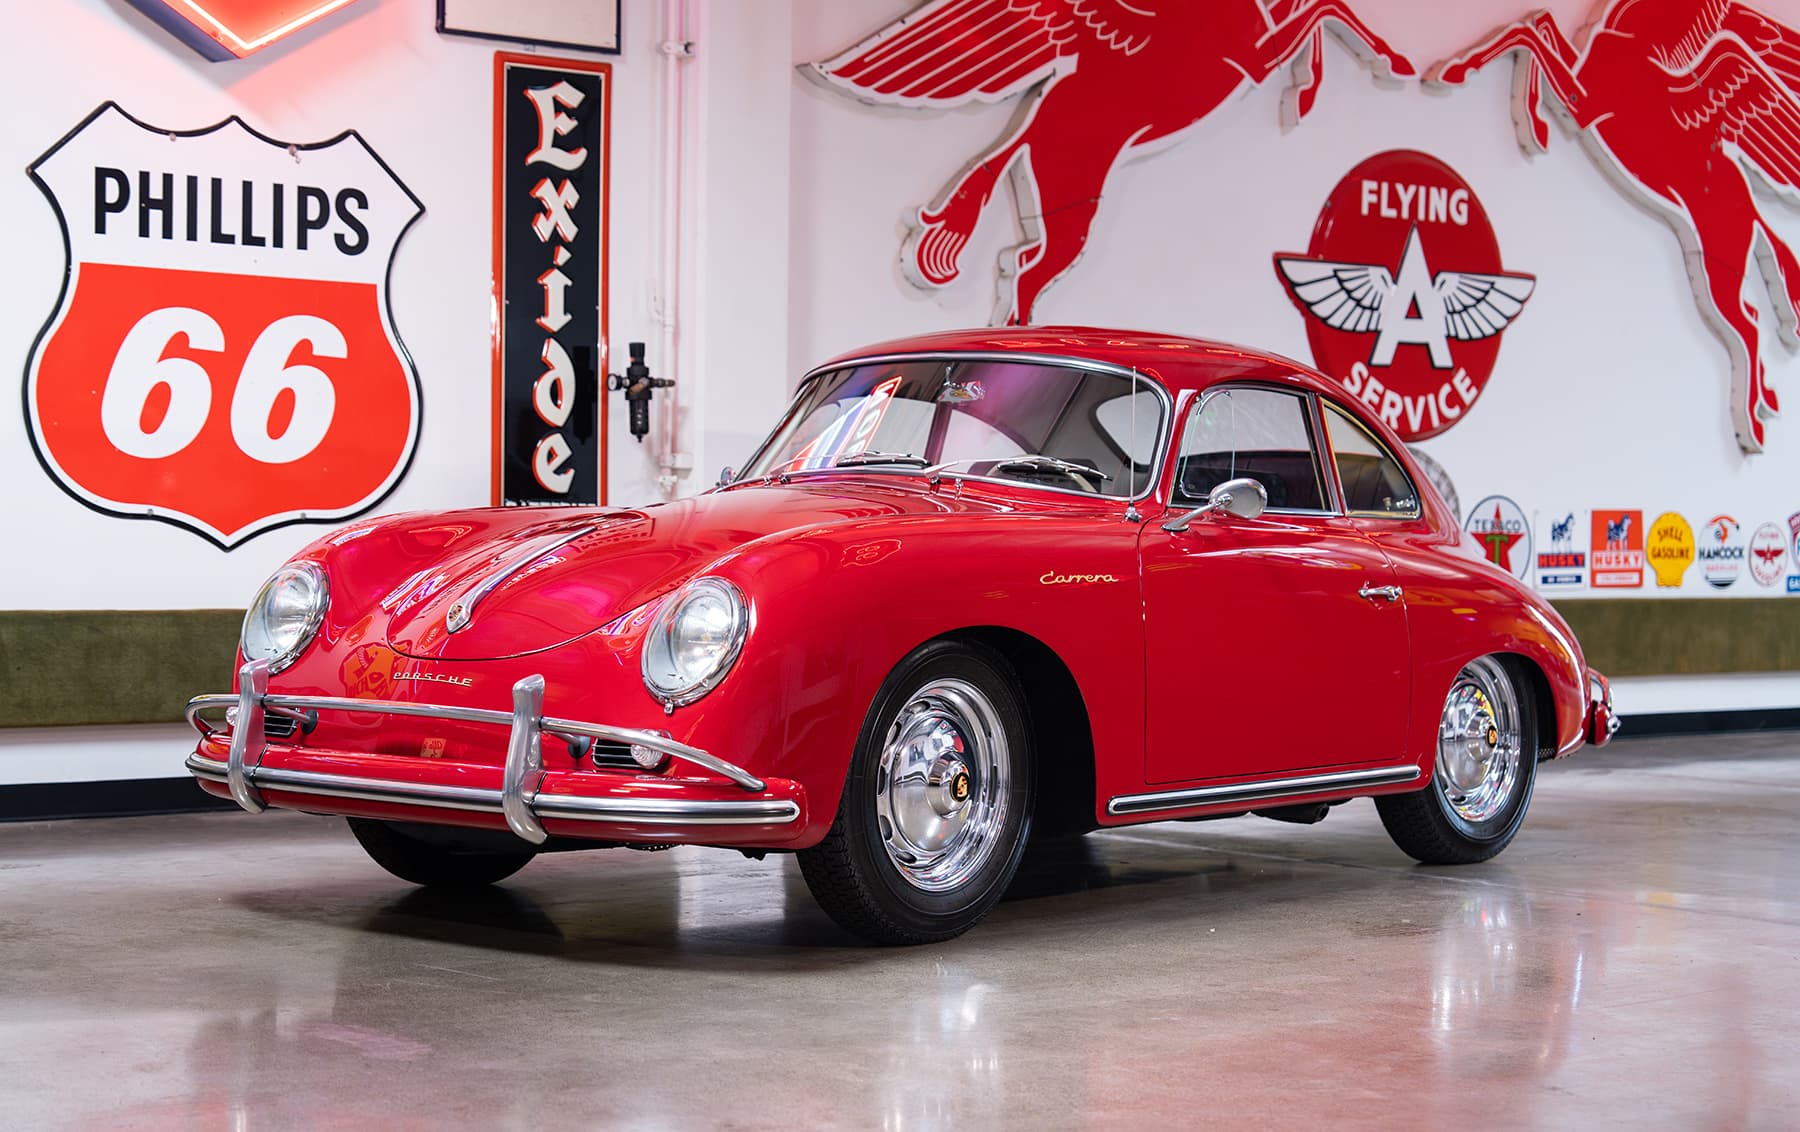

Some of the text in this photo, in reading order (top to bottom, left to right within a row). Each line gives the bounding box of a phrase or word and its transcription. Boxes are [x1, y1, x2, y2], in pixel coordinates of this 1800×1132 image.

[1361, 179, 1469, 226] FLYING
[94, 166, 369, 256] PHILLIPS
[524, 80, 588, 494] Exide
[1367, 221, 1454, 369] A
[101, 306, 349, 464] 66
[1343, 361, 1478, 432] SERVICE
[1474, 519, 1522, 533] TEXACO
[1657, 526, 1684, 542] SHELL
[1594, 553, 1640, 567] HUSKY
[1651, 546, 1690, 560] GASOLINE
[1699, 546, 1745, 560] HANCOCK
[1538, 554, 1585, 568] HUSKY
[1040, 570, 1119, 585] Carrera
[393, 672, 473, 687] PORSCHE
